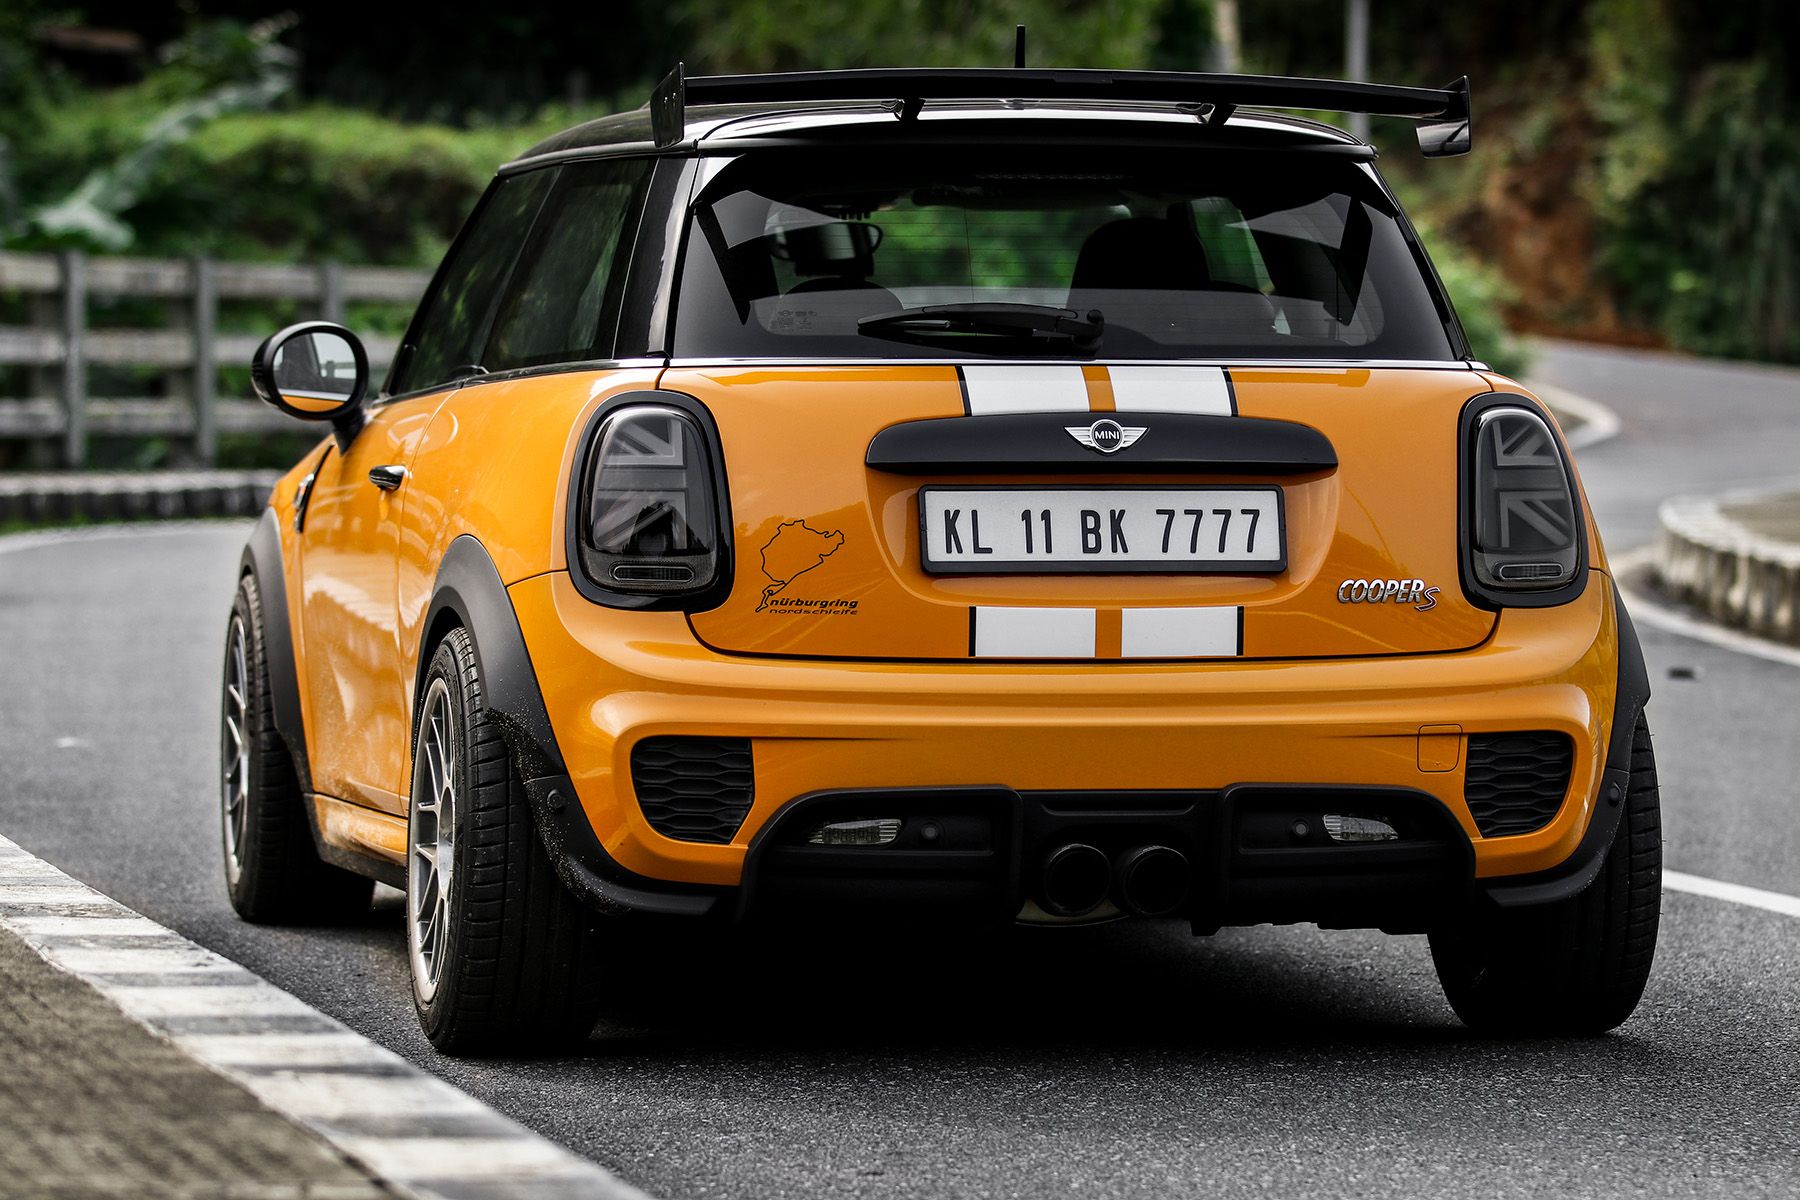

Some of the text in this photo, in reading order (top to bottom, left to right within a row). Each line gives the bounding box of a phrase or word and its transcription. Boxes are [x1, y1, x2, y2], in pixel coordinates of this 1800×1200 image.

[1094, 430, 1120, 440] MINI
[943, 509, 1261, 554] KL 11 BK 7777
[769, 598, 859, 609] nürburgring
[1338, 579, 1441, 612] COOPER S
